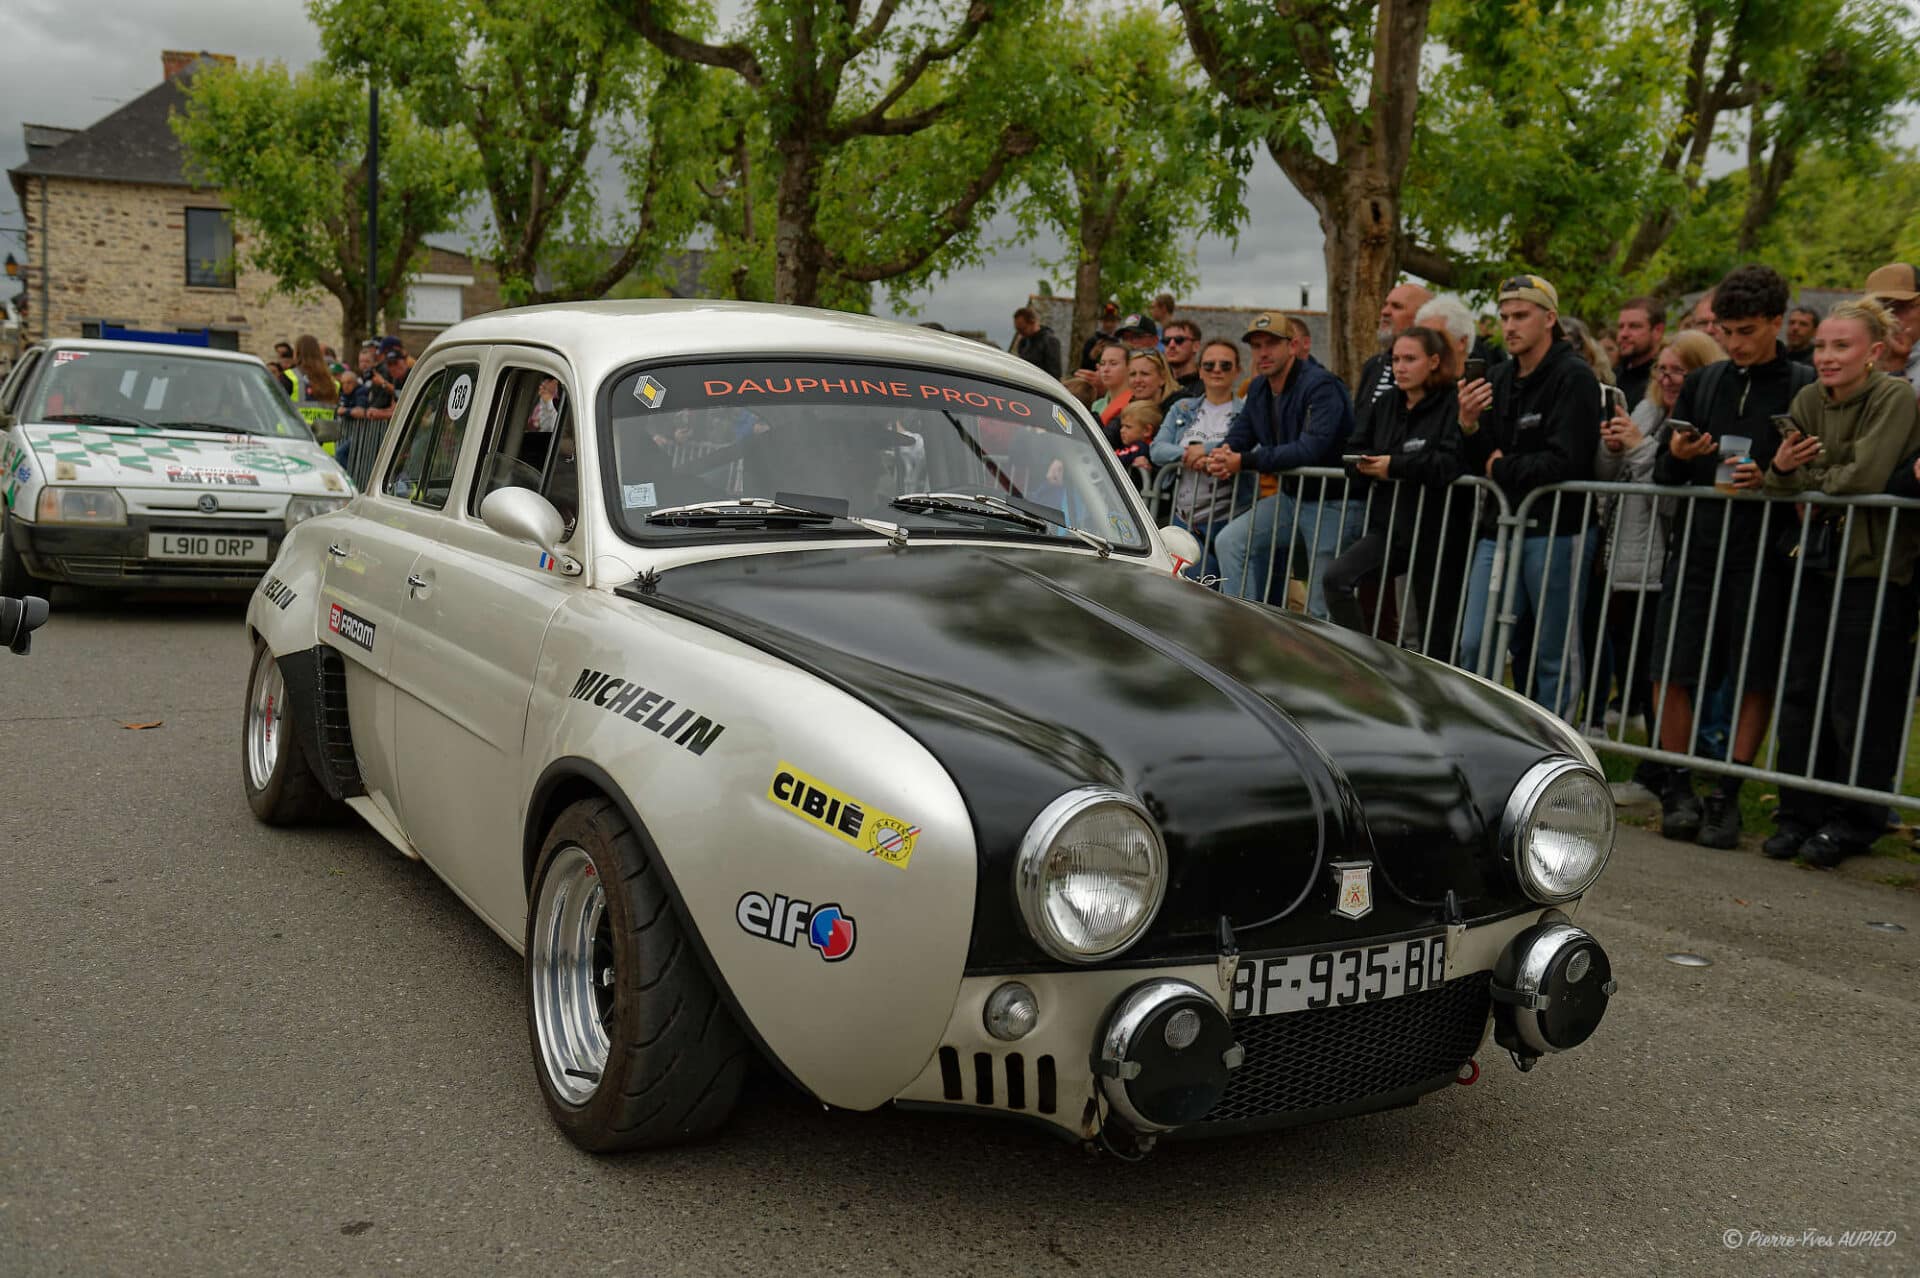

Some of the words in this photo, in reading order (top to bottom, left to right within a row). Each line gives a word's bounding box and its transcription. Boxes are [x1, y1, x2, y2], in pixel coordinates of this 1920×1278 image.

[452, 384, 468, 409] 138
[703, 378, 912, 398] DAUPHINE
[919, 385, 1032, 416] PROTO
[162, 536, 209, 555] L910
[215, 539, 254, 556] ORP
[340, 613, 374, 648] FACOM
[569, 668, 726, 756] MICHELIN
[772, 771, 865, 839] CIBIÉ
[738, 891, 811, 947] elf
